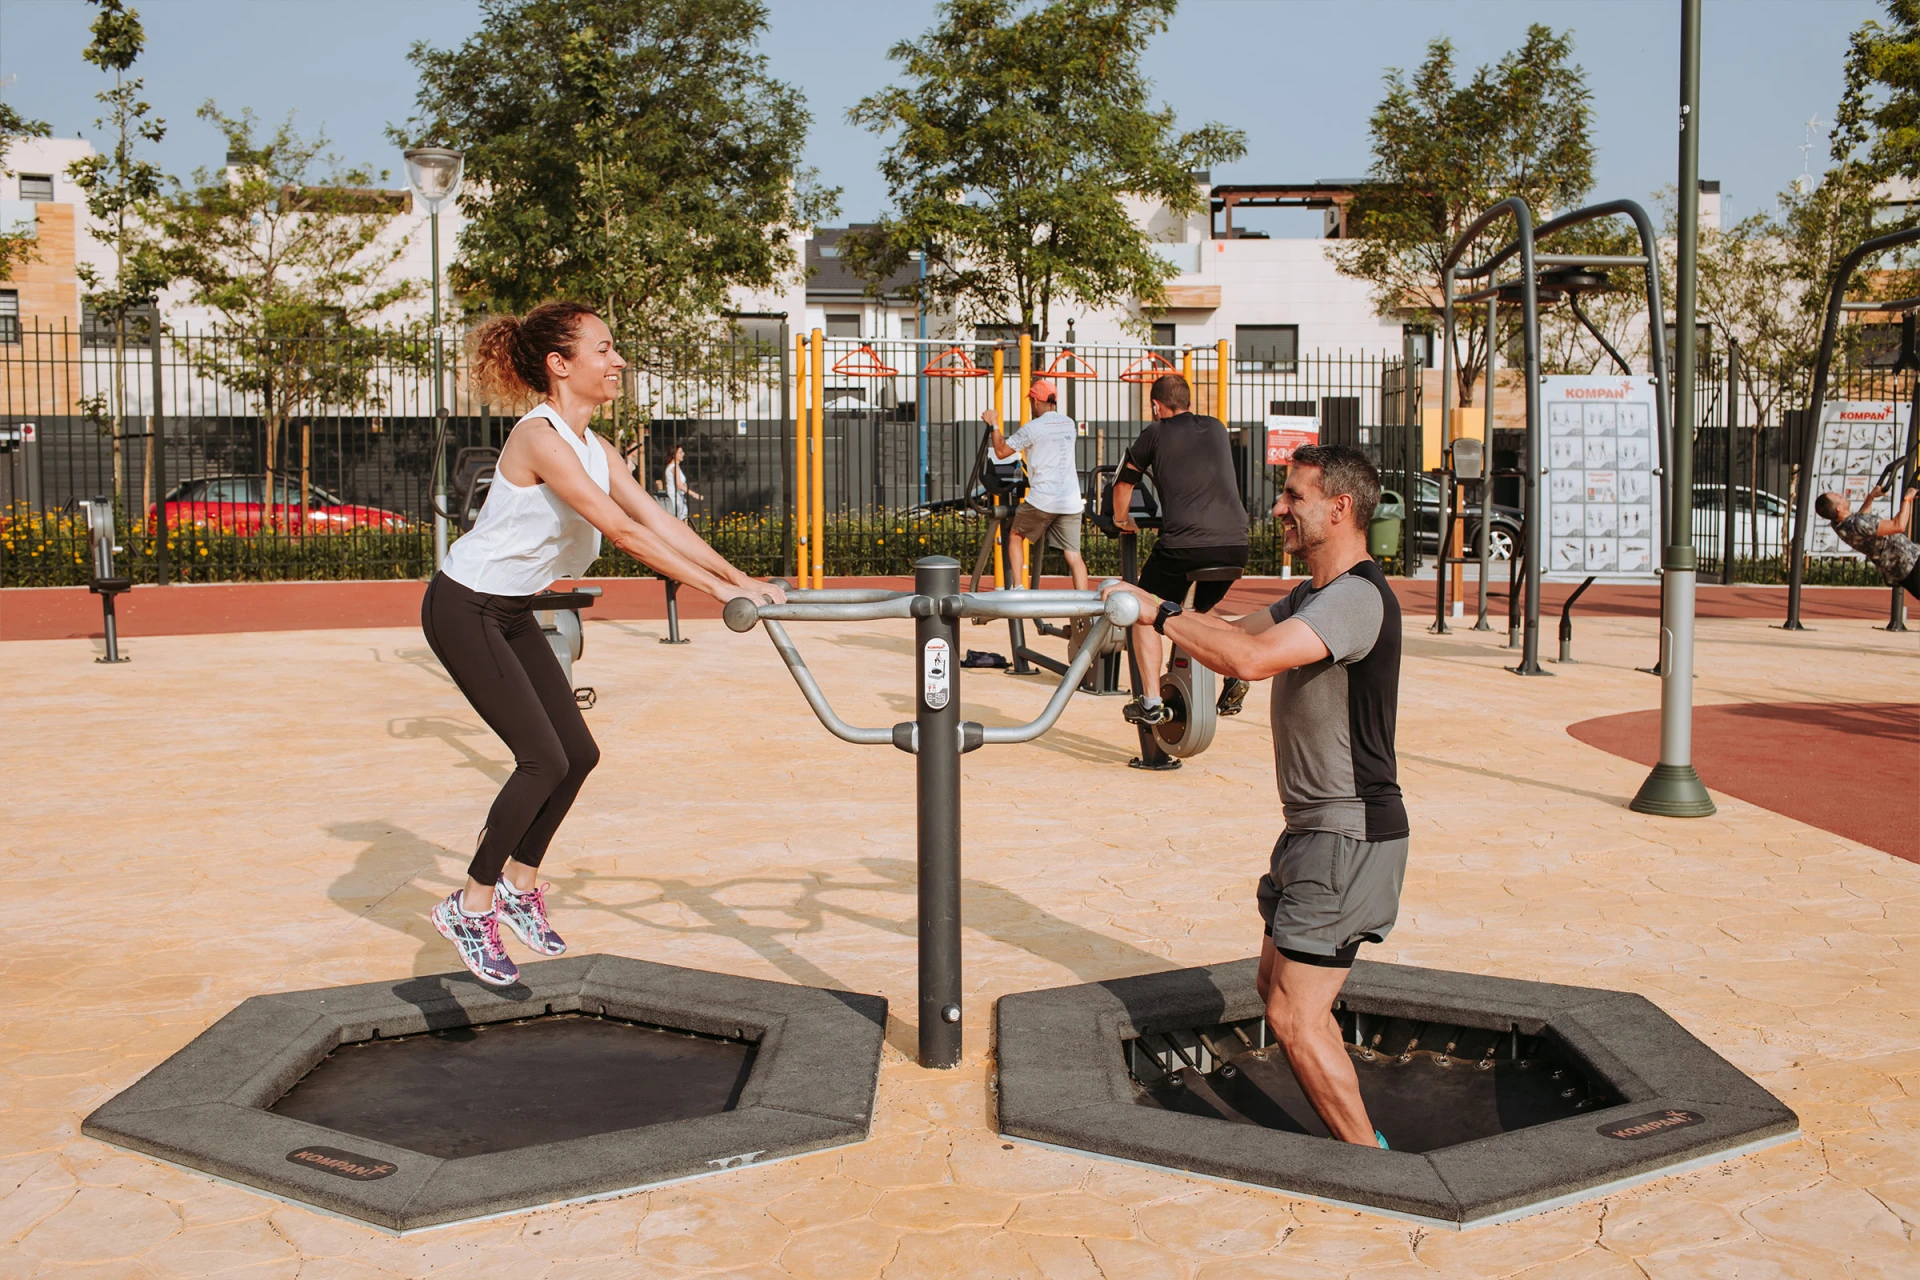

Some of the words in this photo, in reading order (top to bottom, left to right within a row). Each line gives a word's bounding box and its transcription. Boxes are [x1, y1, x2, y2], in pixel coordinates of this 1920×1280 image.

[1565, 388, 1624, 399] KOMPAN
[1840, 411, 1885, 421] KOMPAN
[1612, 1115, 1688, 1138] KOMPAN
[294, 1151, 371, 1176] KOMPAN
